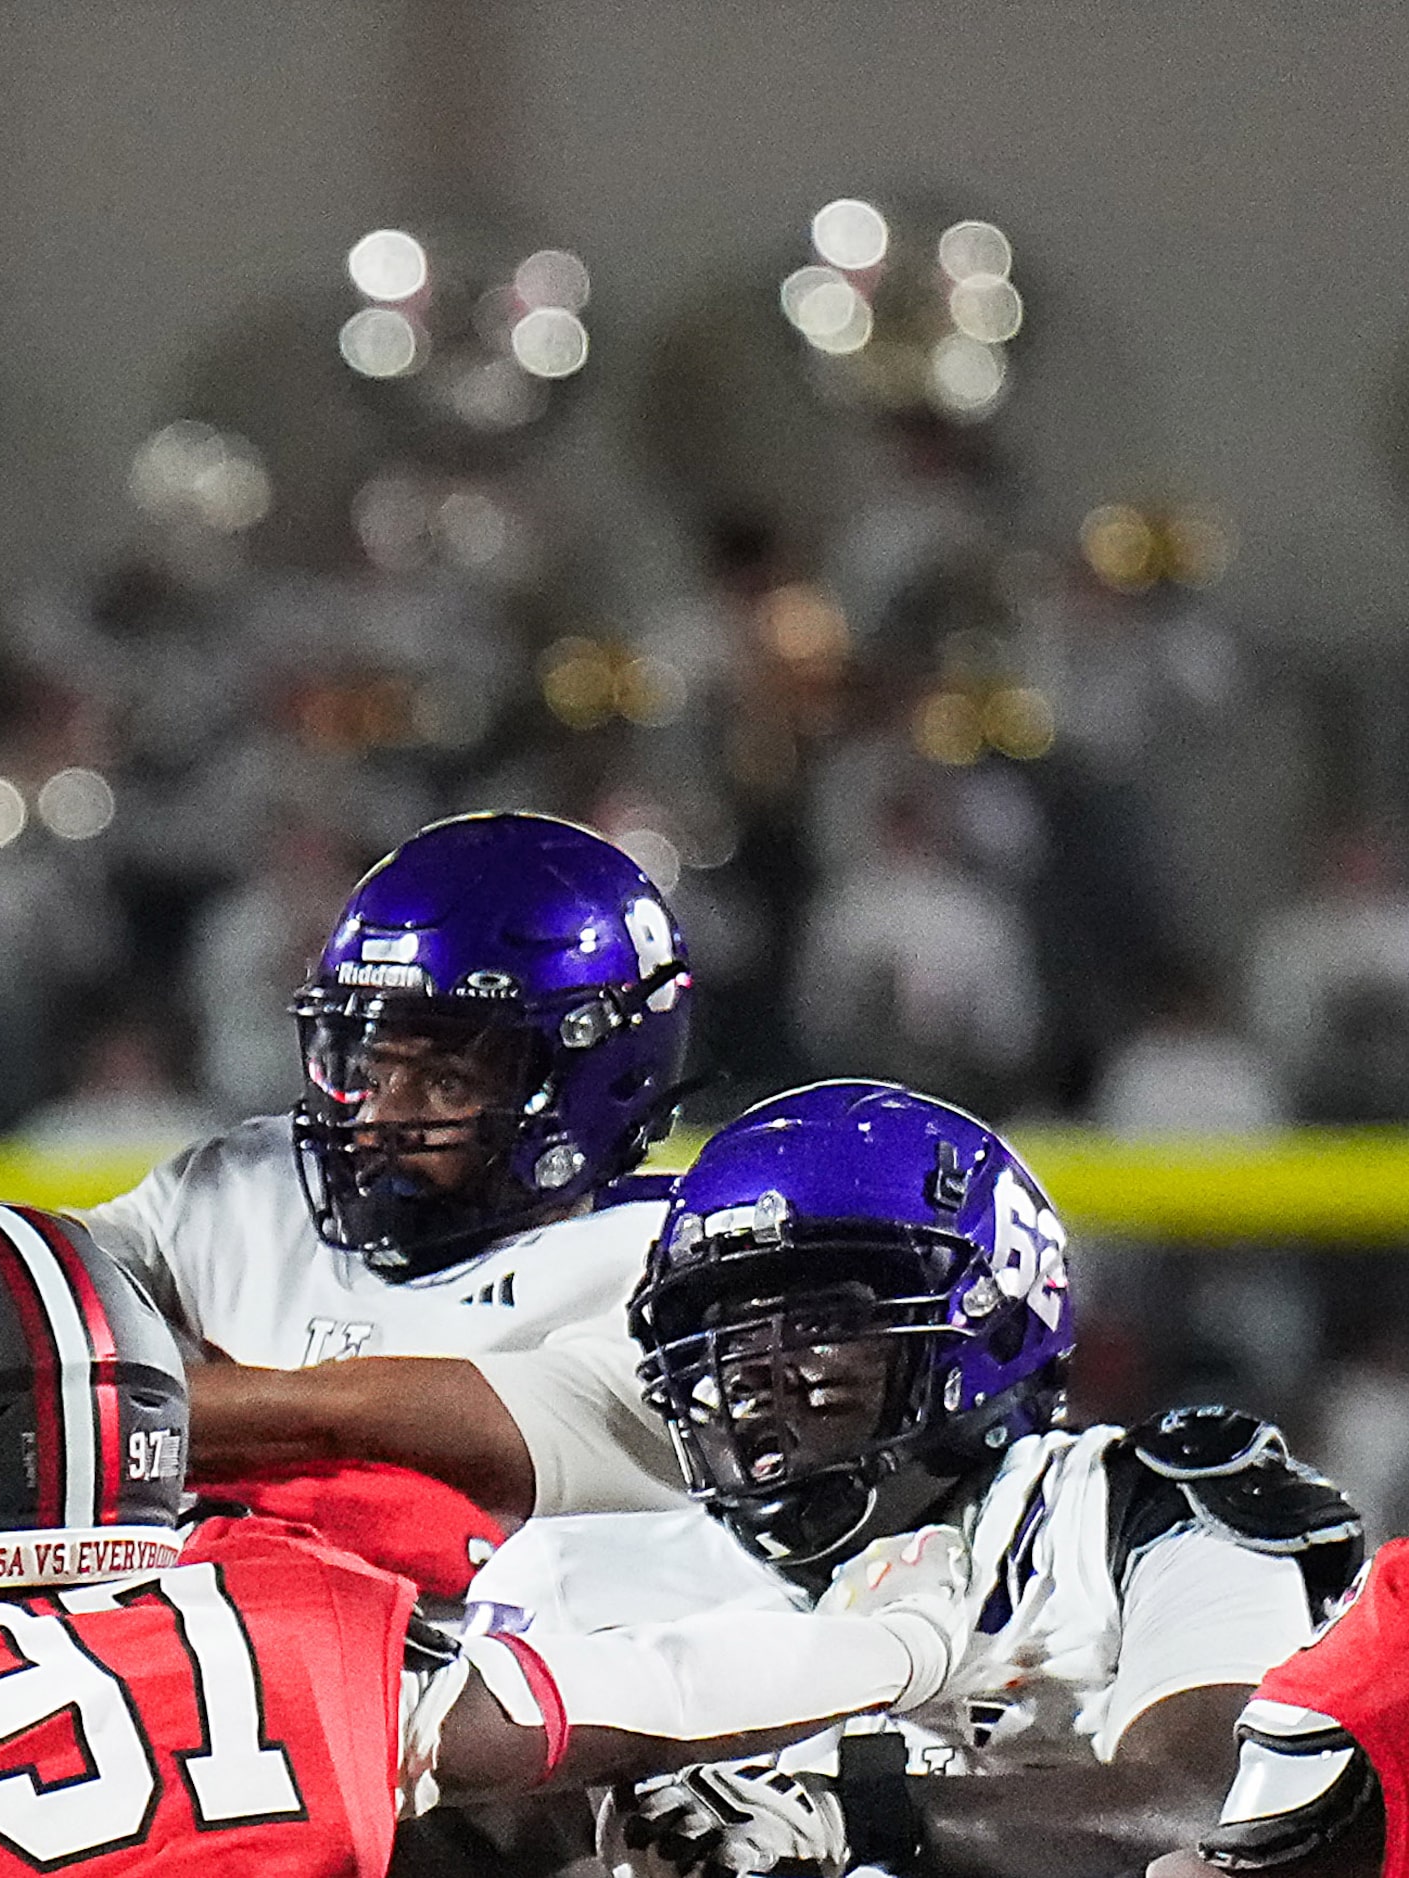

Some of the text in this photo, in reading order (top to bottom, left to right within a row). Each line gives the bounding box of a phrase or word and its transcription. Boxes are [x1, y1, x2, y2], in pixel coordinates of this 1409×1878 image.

[993, 1167, 1068, 1333] 62
[129, 1428, 171, 1479] 97
[34, 1542, 70, 1576] VS.
